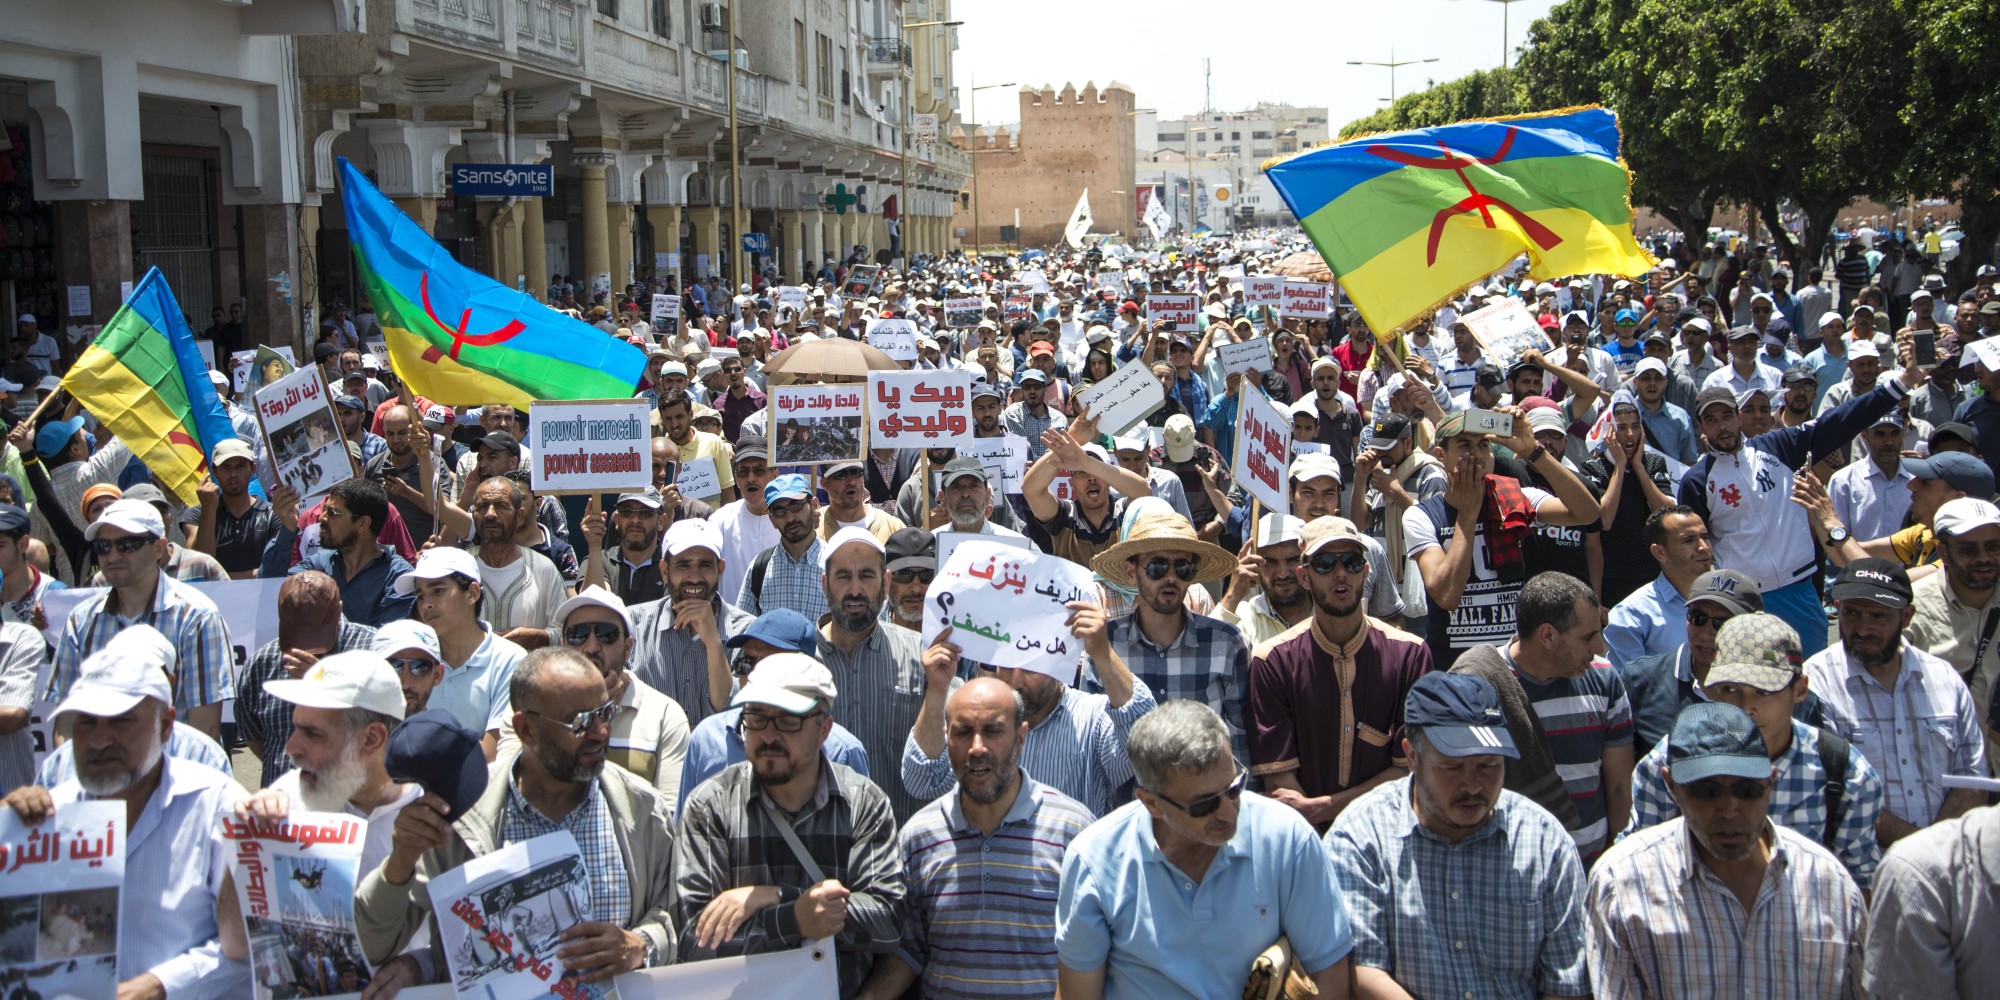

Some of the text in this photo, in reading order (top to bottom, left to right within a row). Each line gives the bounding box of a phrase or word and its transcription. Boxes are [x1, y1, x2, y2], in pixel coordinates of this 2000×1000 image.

[457, 168, 548, 187] Samsonite
[1152, 312, 1195, 324] الشبا
[1286, 299, 1325, 313] الشباب
[871, 326, 913, 337] الظلم ظلمات
[873, 341, 911, 352] يوم القيامة
[302, 373, 320, 401] أين
[877, 380, 964, 410] بيك يا
[778, 393, 860, 413] بلادنا ولات مزبلة
[542, 413, 642, 448] pouvoir marocain
[878, 409, 966, 438] وليدي
[543, 446, 642, 481] pouvoir assassin
[982, 447, 1014, 463] الشعب
[1247, 442, 1280, 494] المعتقلين
[968, 555, 1027, 595] ينزف
[1034, 579, 1082, 605] الريف
[1448, 606, 1487, 626] WALL
[1015, 634, 1041, 651] من
[1045, 636, 1067, 656] هل
[69, 820, 115, 868] أين
[236, 841, 269, 918] والبطالة
[450, 897, 484, 930] كان
[479, 927, 514, 954] خبر
[514, 952, 554, 982] في
